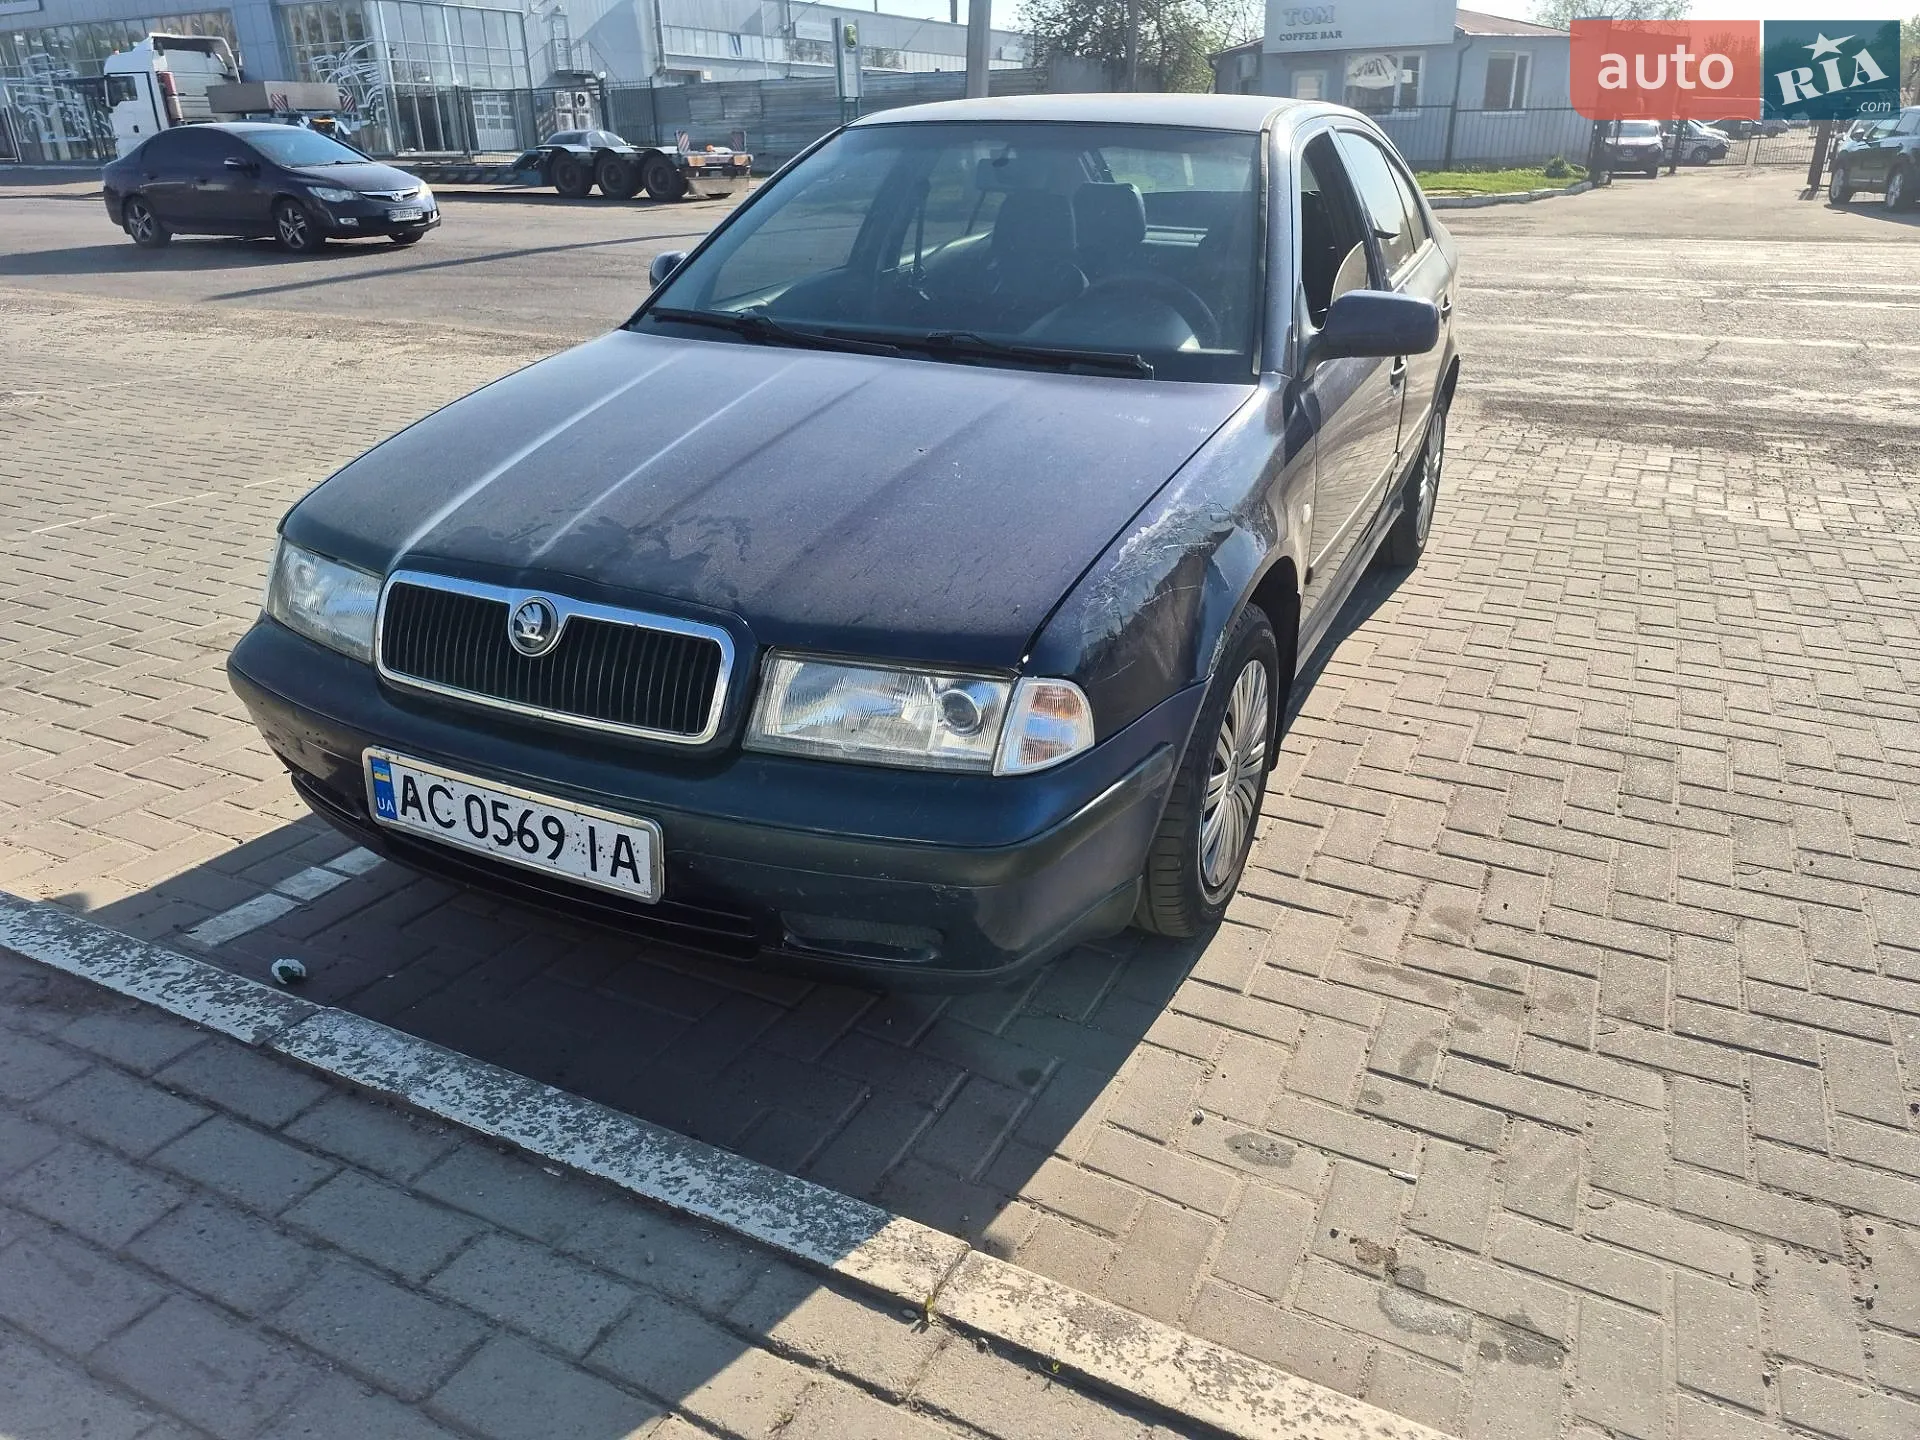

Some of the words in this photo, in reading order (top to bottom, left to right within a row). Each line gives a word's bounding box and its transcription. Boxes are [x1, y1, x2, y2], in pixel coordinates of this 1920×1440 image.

[1282, 5, 1335, 26] TOM
[1279, 32, 1318, 41] COFFEE
[1320, 30, 1343, 39] BAR
[377, 797, 395, 813] UA
[401, 774, 457, 829] AC
[464, 793, 566, 861] 0569
[588, 825, 641, 884] IA
